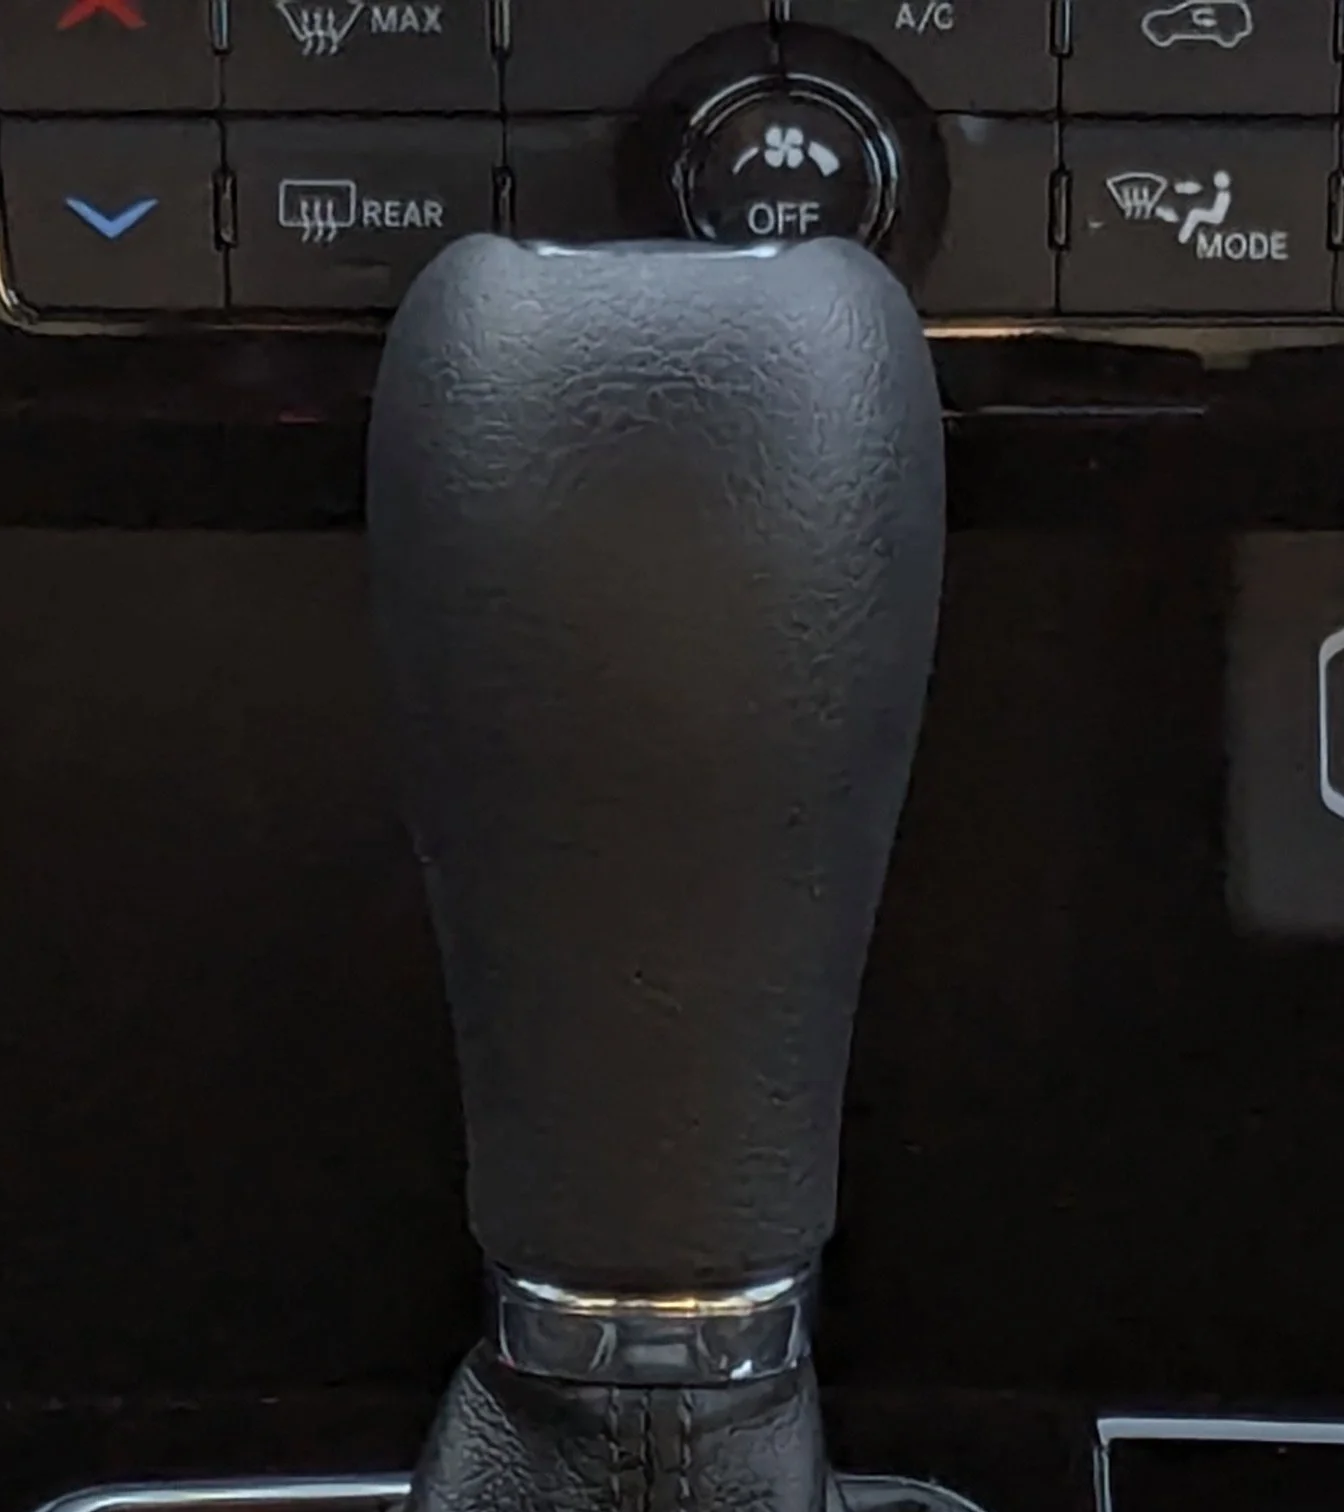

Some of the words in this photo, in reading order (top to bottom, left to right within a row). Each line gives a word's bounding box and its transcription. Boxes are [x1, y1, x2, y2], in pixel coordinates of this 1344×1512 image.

[370, 3, 443, 33] MAX
[894, 1, 955, 31] A/C
[362, 202, 444, 229] REAR
[748, 203, 820, 236] OFF
[1197, 231, 1289, 262] MODE
